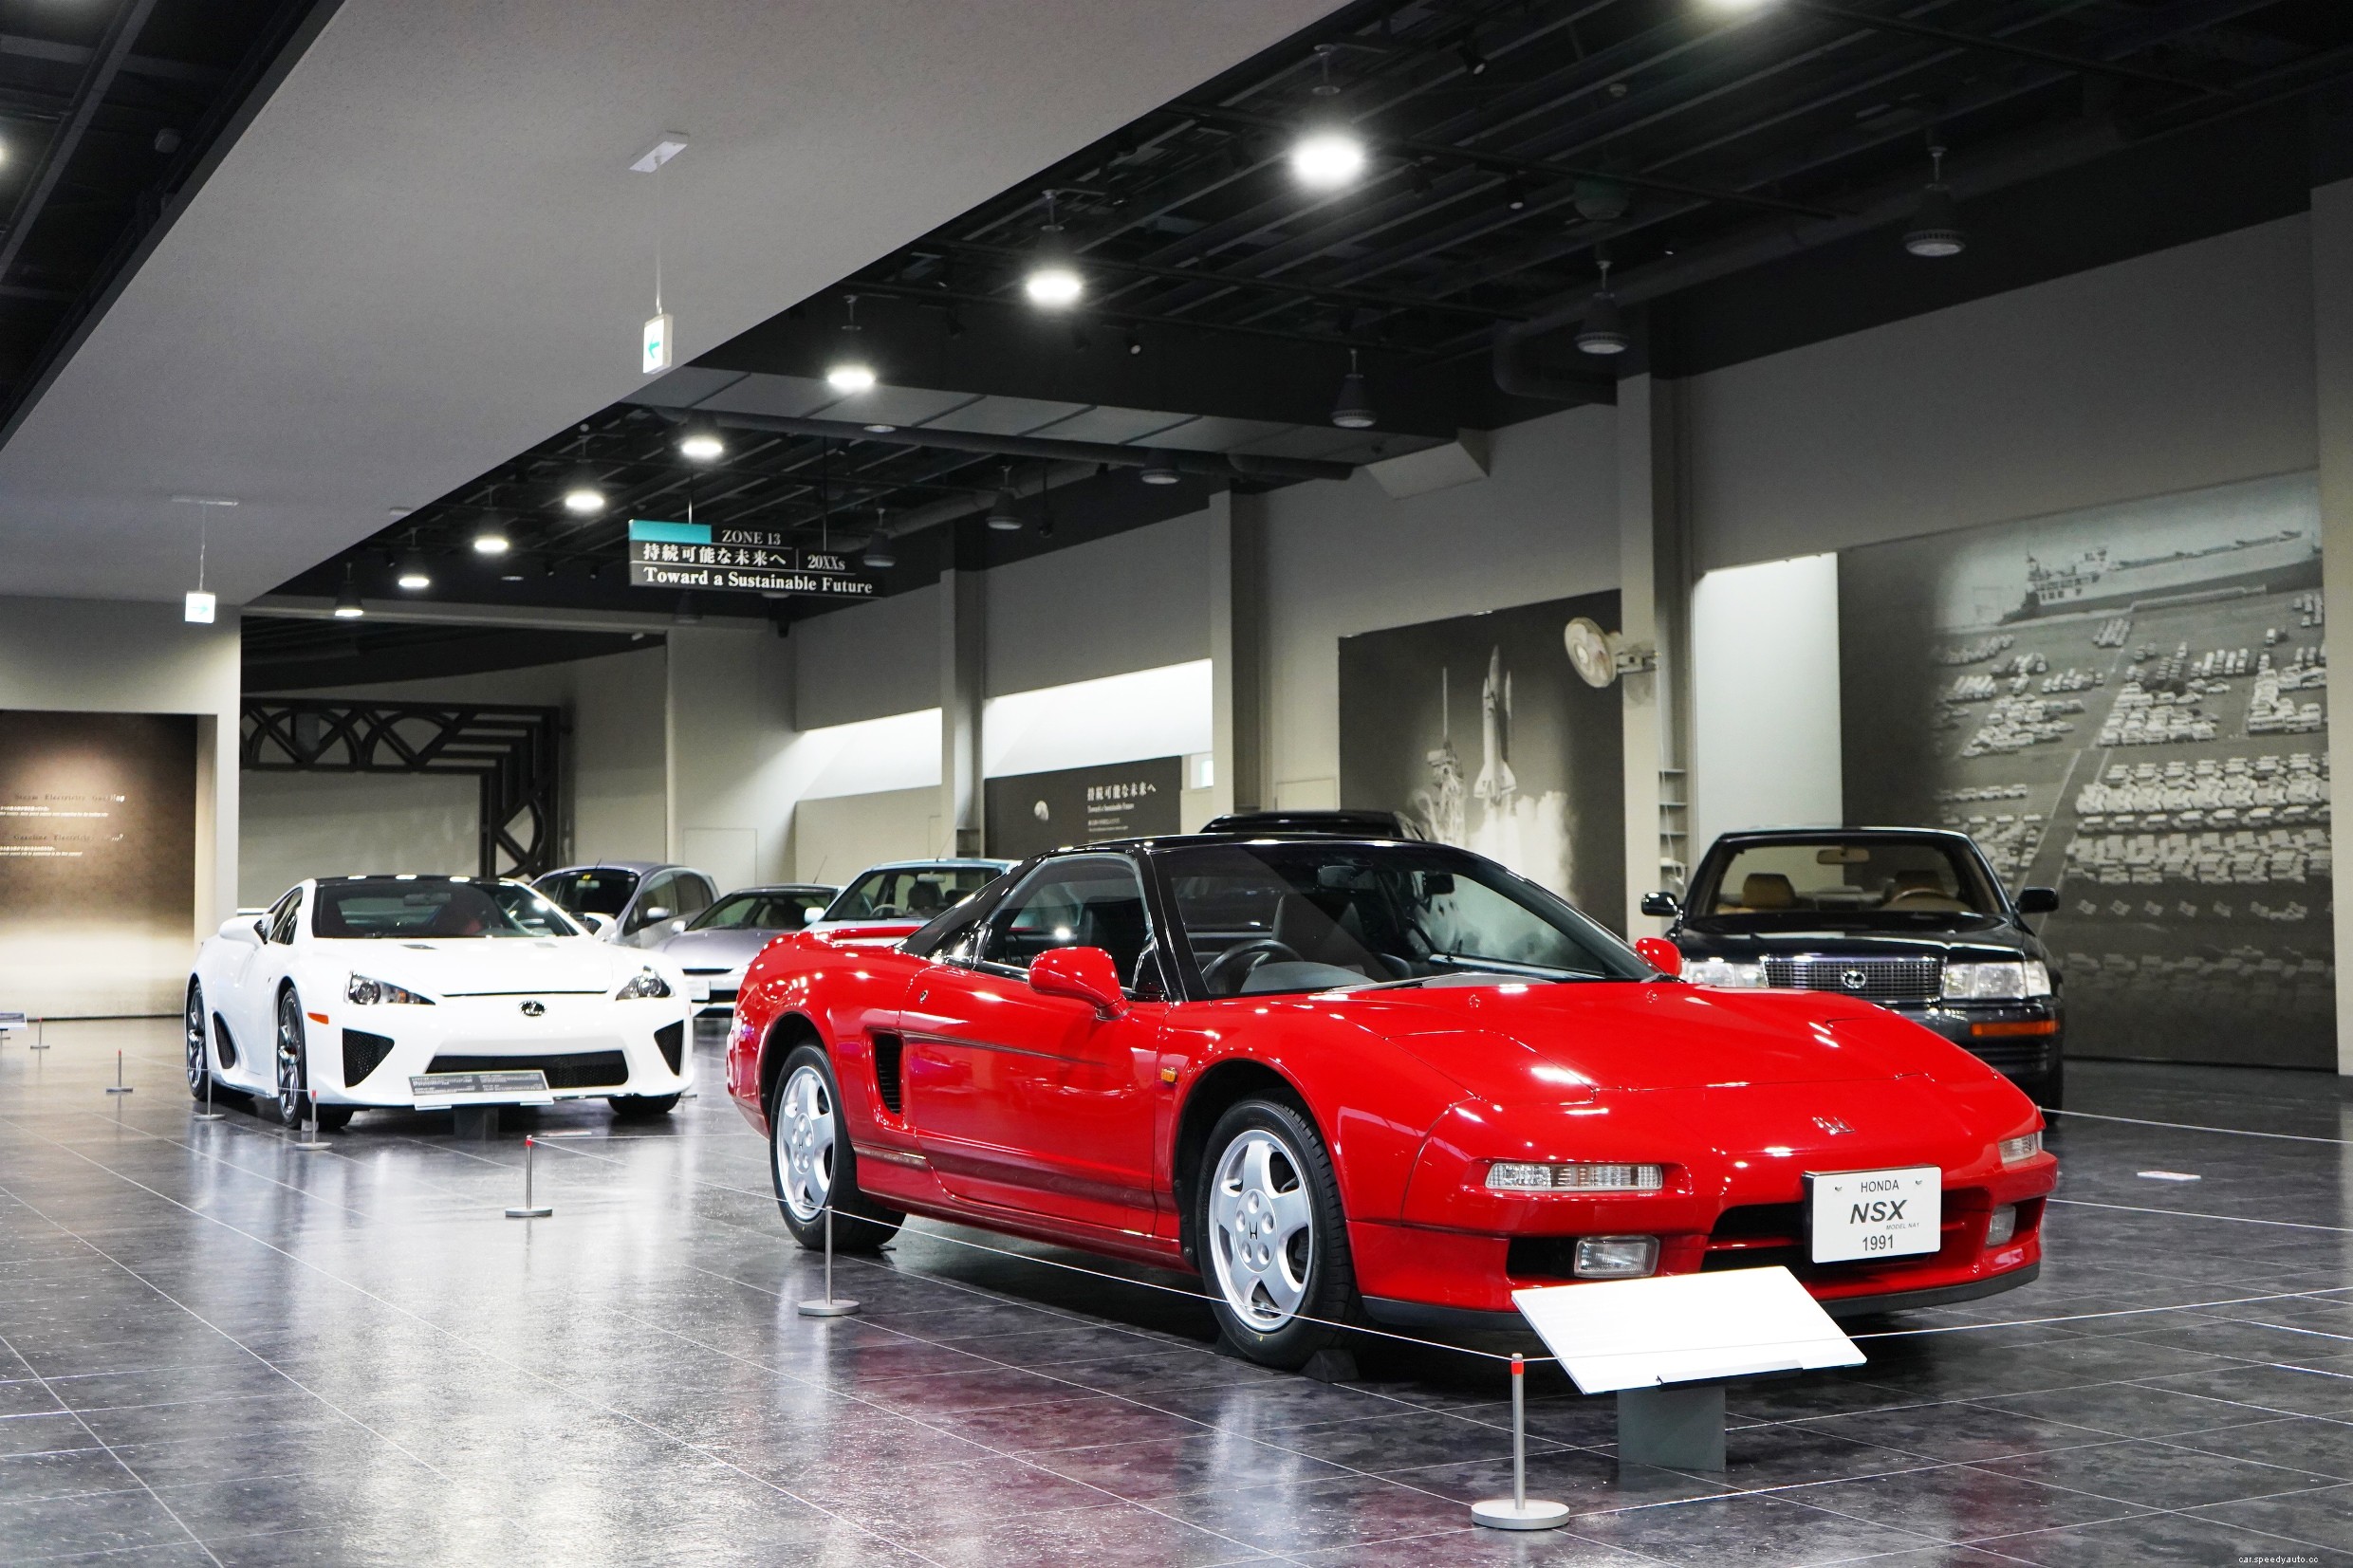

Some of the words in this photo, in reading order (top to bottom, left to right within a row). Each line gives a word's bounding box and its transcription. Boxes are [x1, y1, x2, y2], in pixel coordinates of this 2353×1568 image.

[722, 529, 763, 544] ZONE
[768, 532, 782, 545] 13
[642, 543, 787, 567] 持続可能な未来へ
[806, 554, 846, 571] 20XXs
[642, 566, 709, 585] Toward
[713, 574, 724, 586] a
[728, 571, 817, 591] Sustainable
[822, 577, 873, 594] Future
[1861, 1179, 1899, 1193] HONDA
[1849, 1199, 1907, 1224] NSX
[1862, 1233, 1894, 1251] 1991
